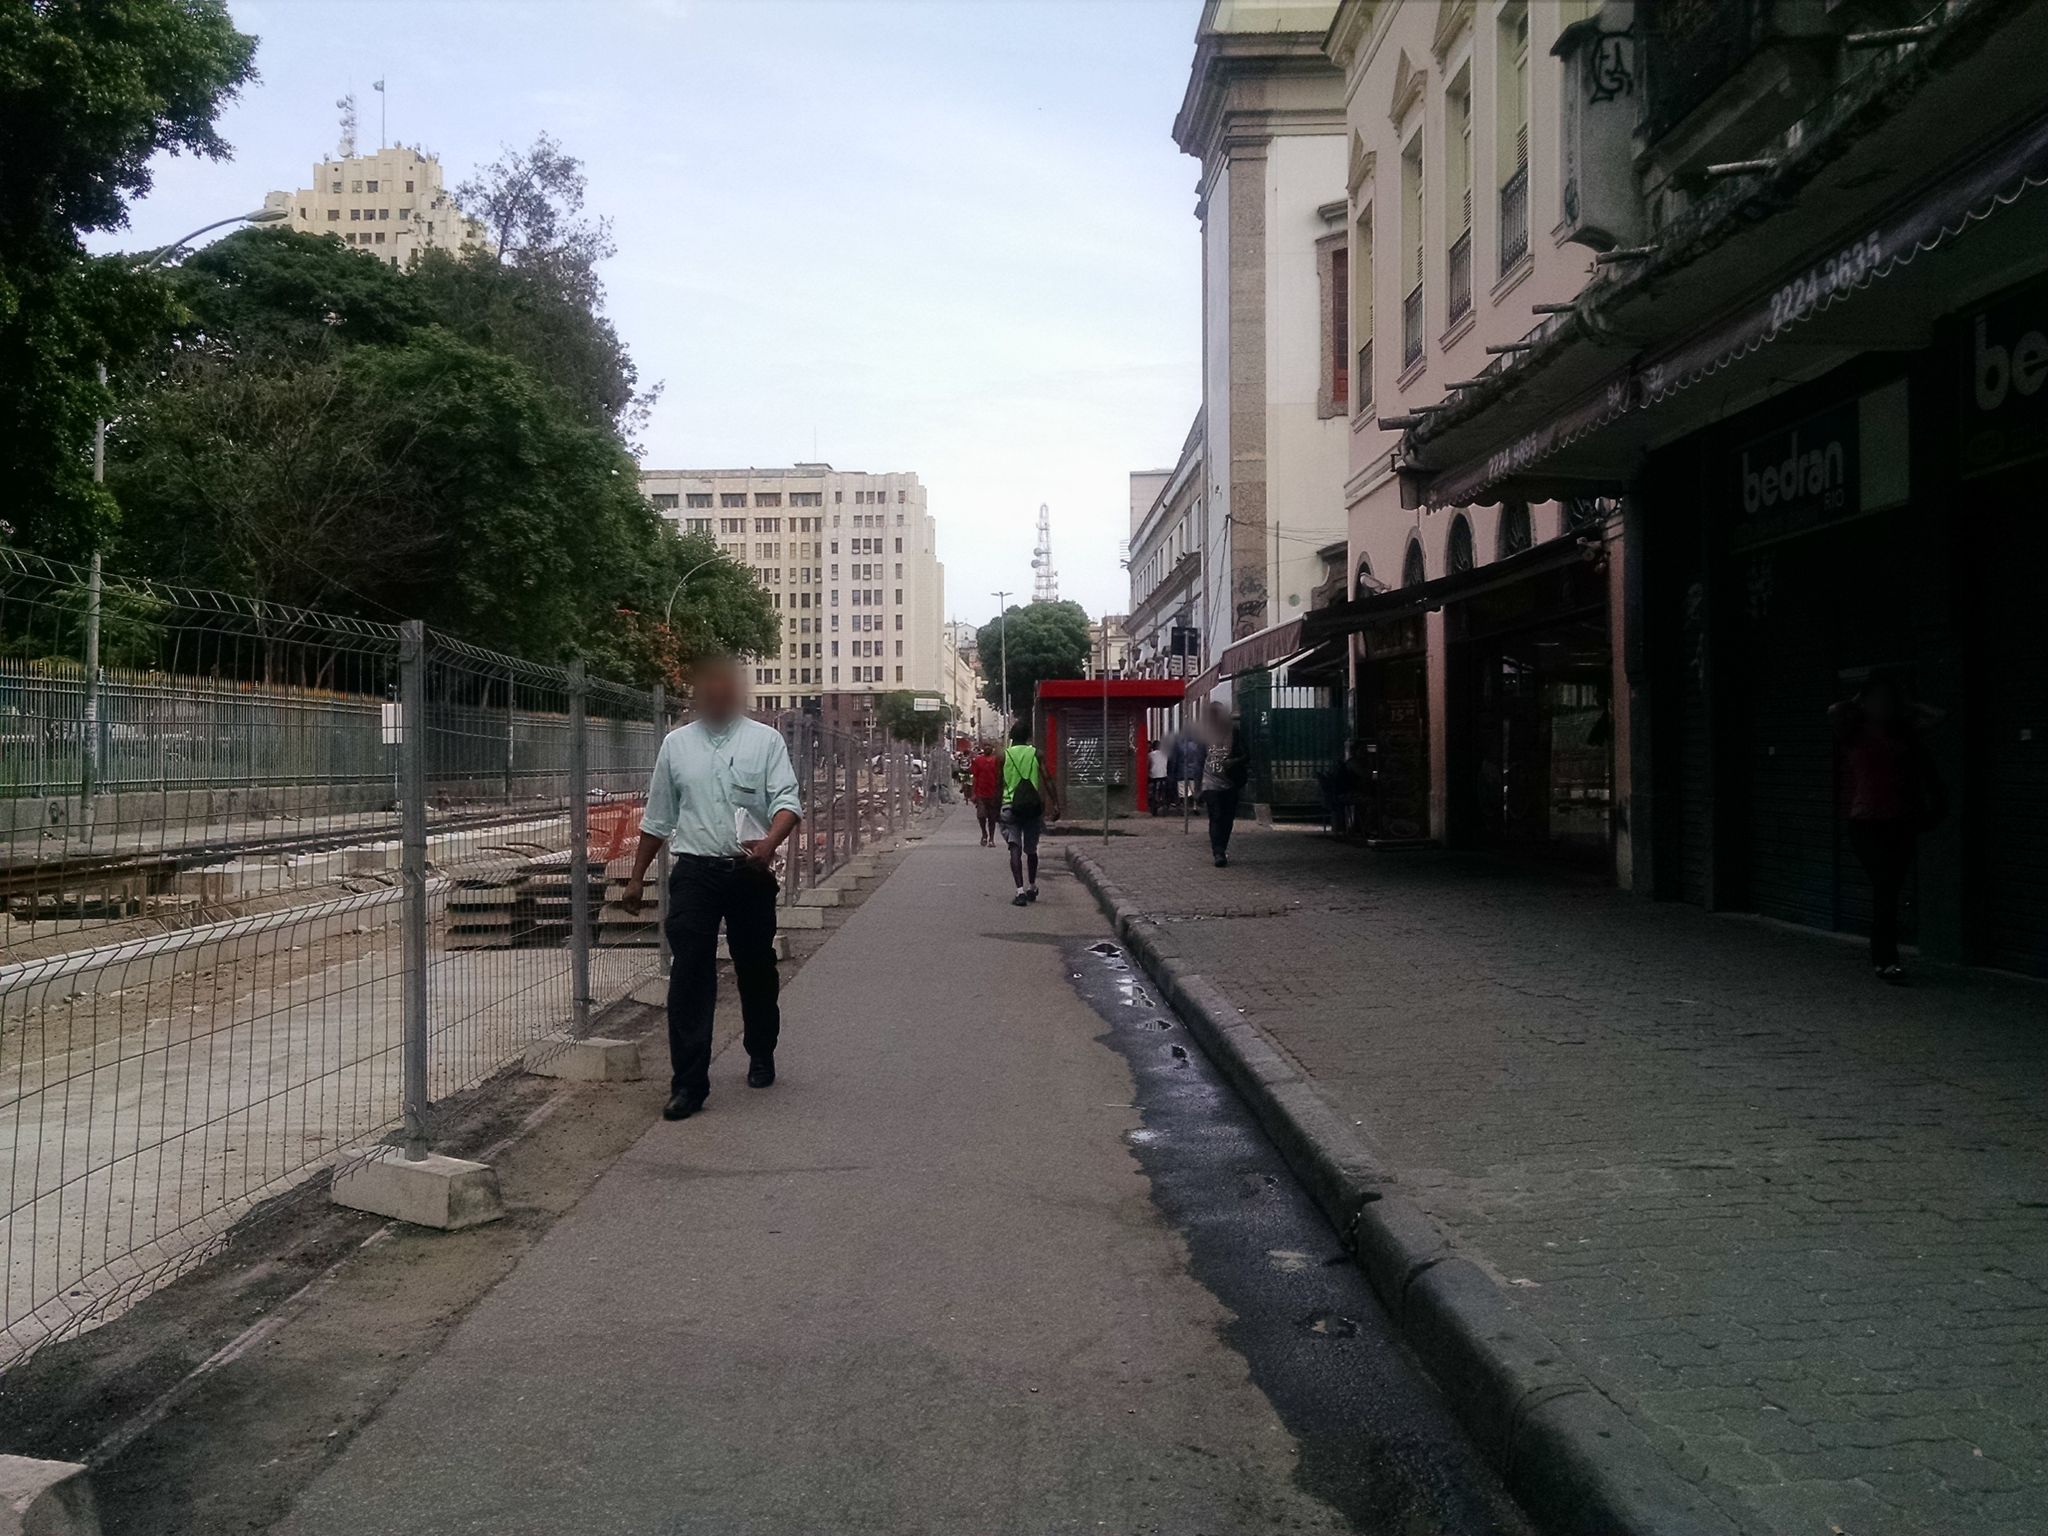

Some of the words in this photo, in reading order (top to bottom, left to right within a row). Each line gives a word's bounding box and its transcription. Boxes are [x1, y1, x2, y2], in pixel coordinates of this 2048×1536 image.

[1771, 268, 1818, 331] 2224
[1825, 230, 1881, 294] 3635
[1741, 430, 1845, 514] bedran
